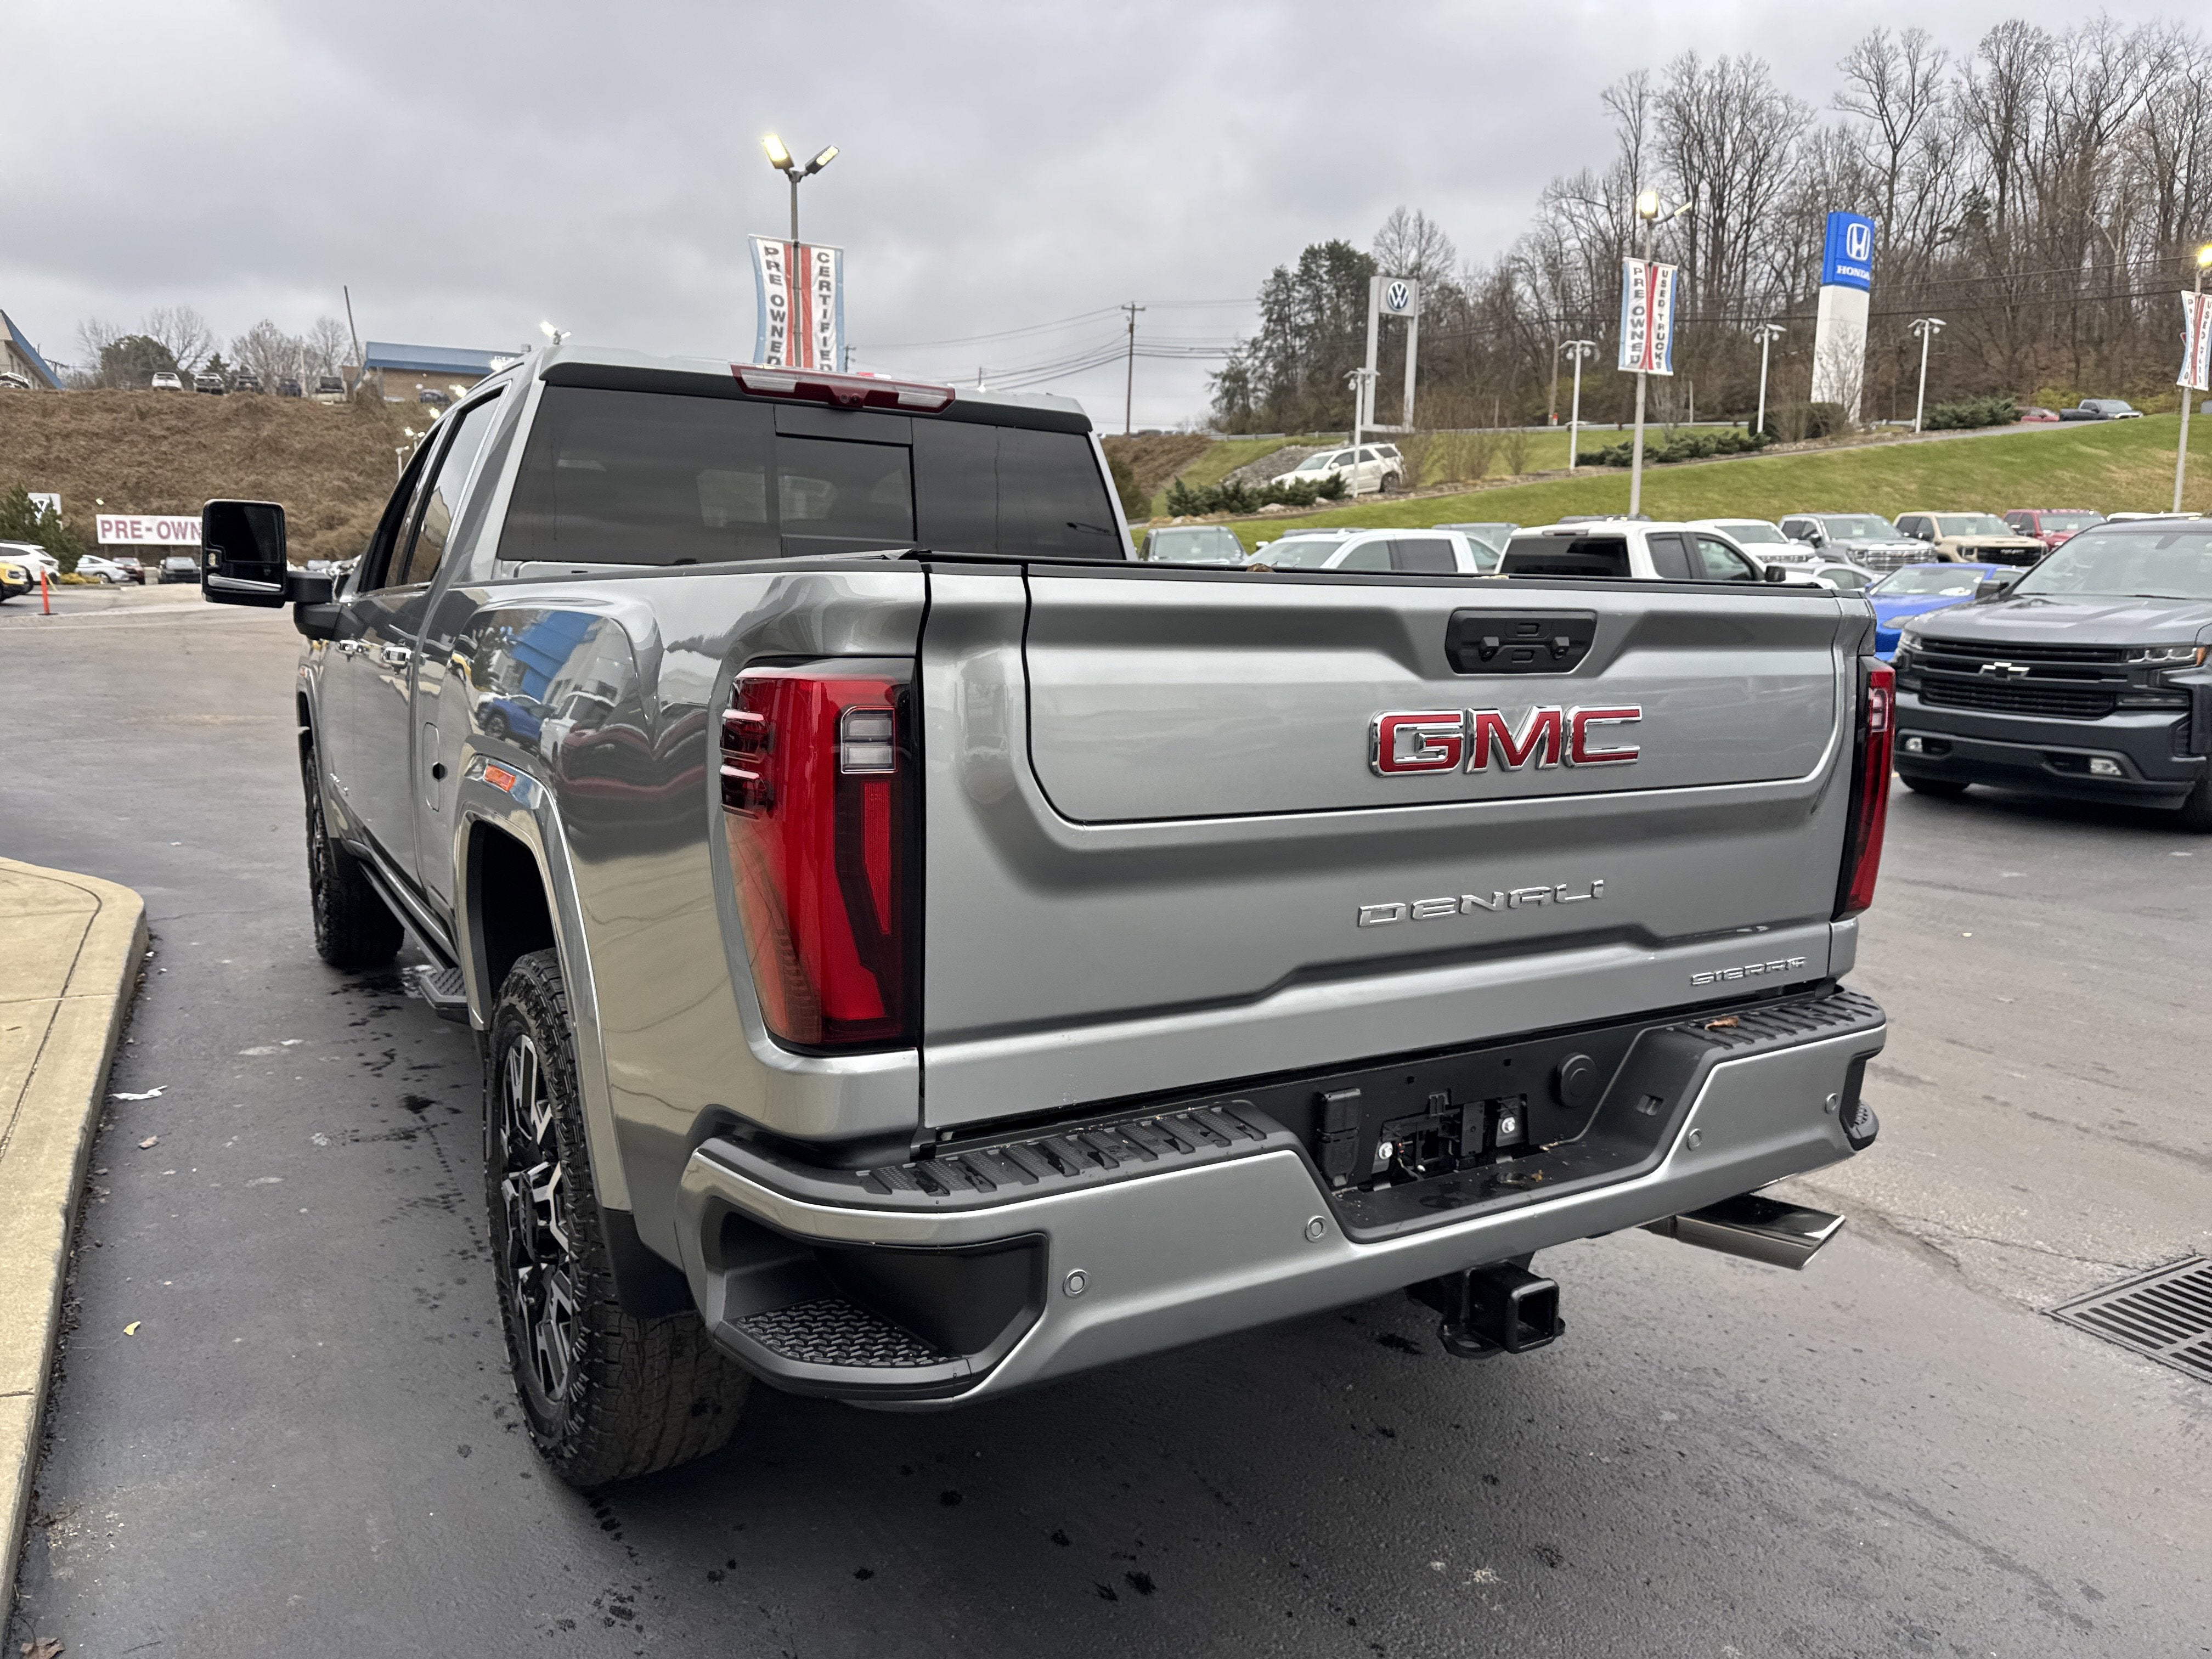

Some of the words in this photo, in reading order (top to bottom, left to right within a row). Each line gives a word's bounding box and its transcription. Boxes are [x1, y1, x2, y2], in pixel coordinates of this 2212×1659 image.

[764, 246, 783, 286] PRE
[1633, 267, 1645, 298] PRE
[1836, 264, 1870, 281] HONDA
[1658, 269, 1669, 307] USED
[1630, 306, 1645, 364] OWNED
[1655, 313, 1666, 369] TRUCKS
[1370, 705, 1643, 776] GMC
[1358, 879, 1604, 928] DENALI
[1691, 956, 1807, 986] SIERRA
